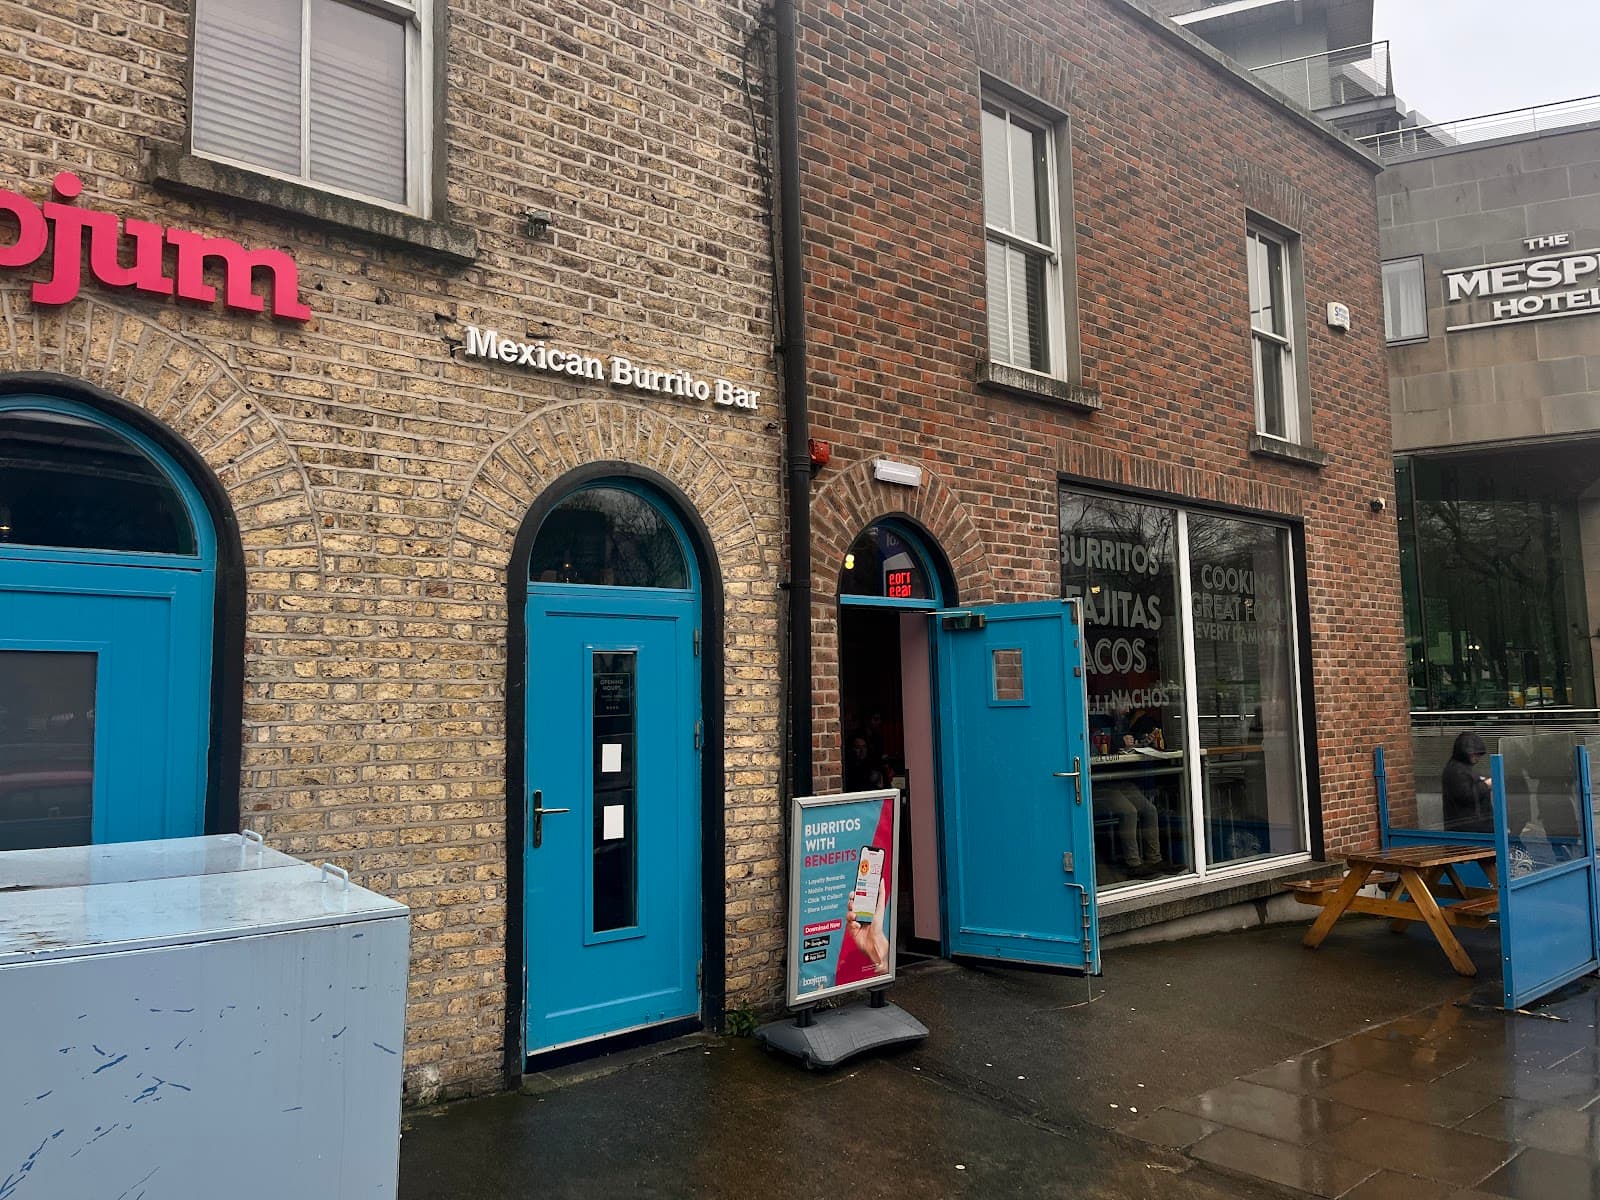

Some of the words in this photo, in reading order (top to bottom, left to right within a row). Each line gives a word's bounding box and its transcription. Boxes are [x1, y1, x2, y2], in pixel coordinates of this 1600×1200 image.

[1523, 233, 1569, 250] THE
[1447, 255, 1600, 300] MESP
[1492, 287, 1600, 318] HOTEL
[464, 326, 604, 380] Mexican
[609, 355, 710, 400] Burrito
[714, 377, 760, 410] Bar
[1060, 534, 1160, 576] BURRITOS
[1191, 591, 1241, 621] GREAT
[1195, 621, 1231, 641] EVERY
[1084, 637, 1147, 675] ACOS
[1111, 687, 1170, 711] NACHOS
[804, 818, 861, 837] BURRITOS
[805, 837, 836, 852] WITH
[804, 849, 857, 868] BENEFITS
[805, 923, 830, 934] Download
